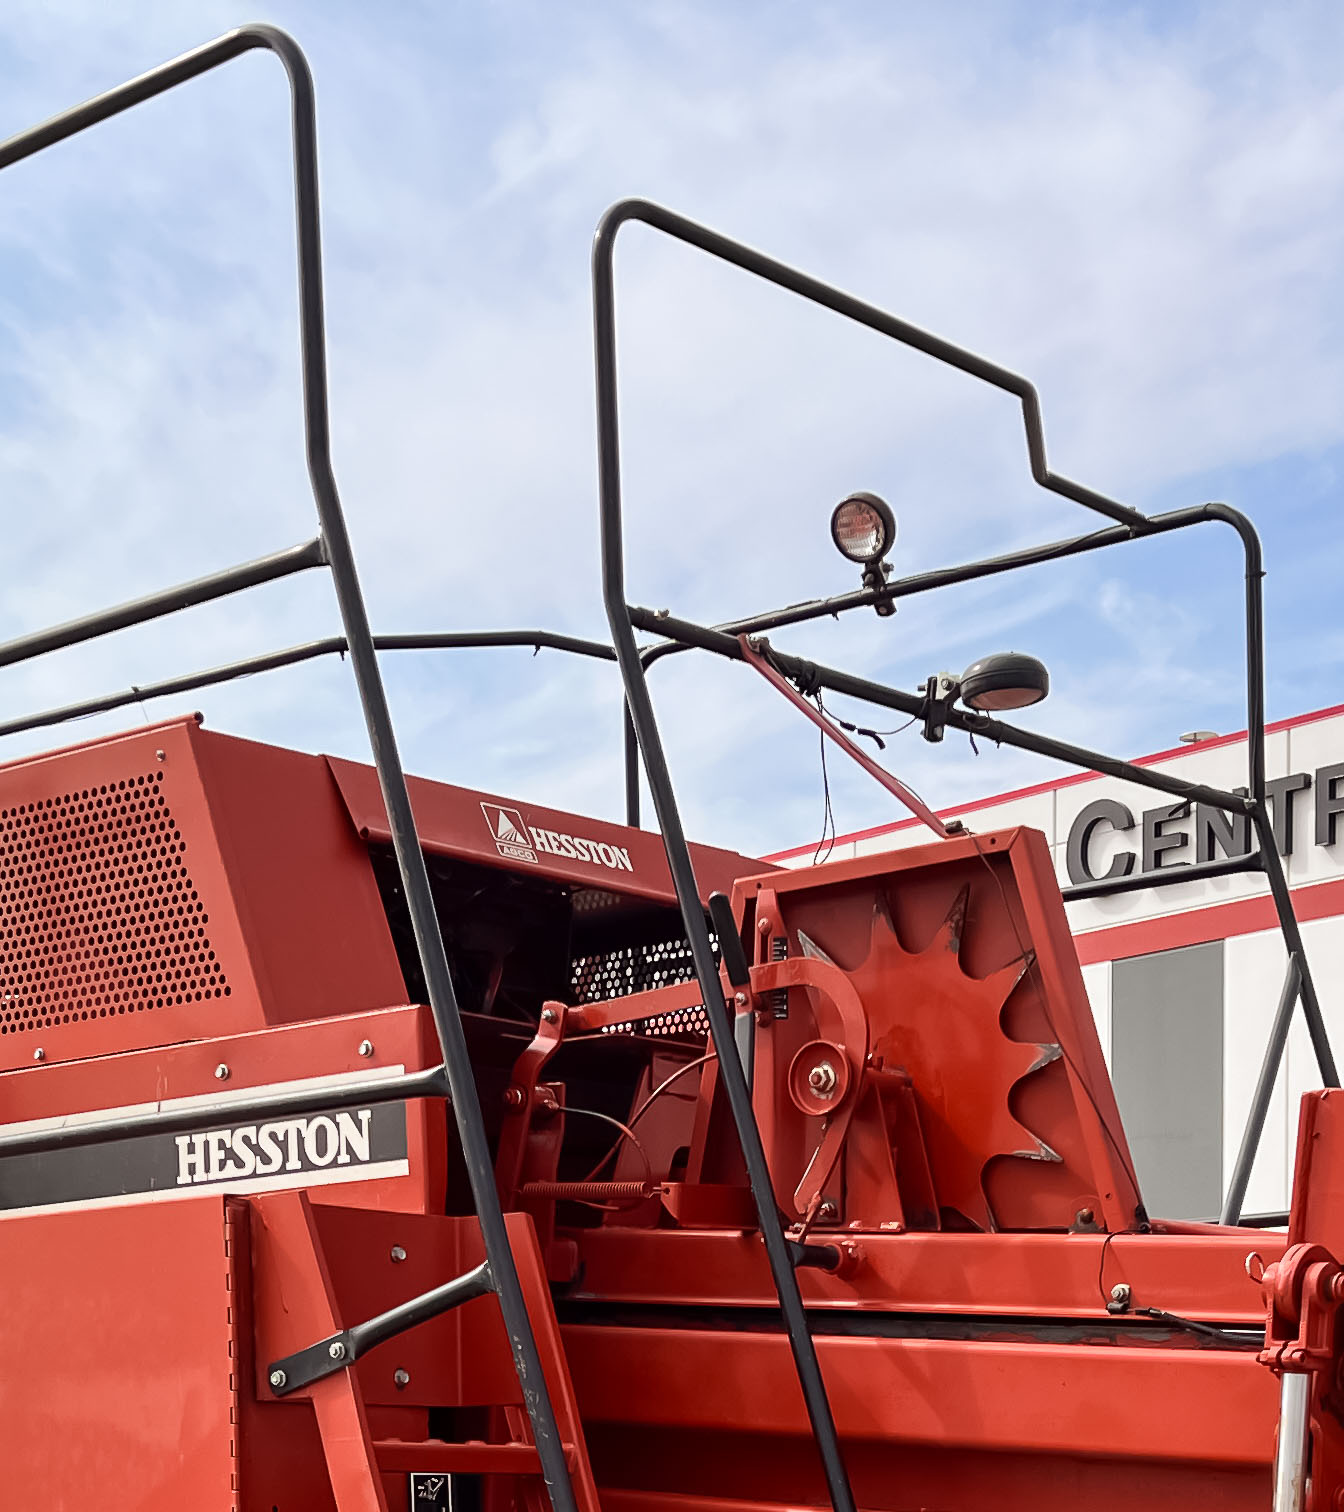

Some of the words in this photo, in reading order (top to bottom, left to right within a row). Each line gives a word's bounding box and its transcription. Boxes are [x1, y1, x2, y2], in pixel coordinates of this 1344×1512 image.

[502, 846, 534, 861] AGCO
[528, 826, 634, 872] HESSTON
[175, 1109, 373, 1186] HESSTON
